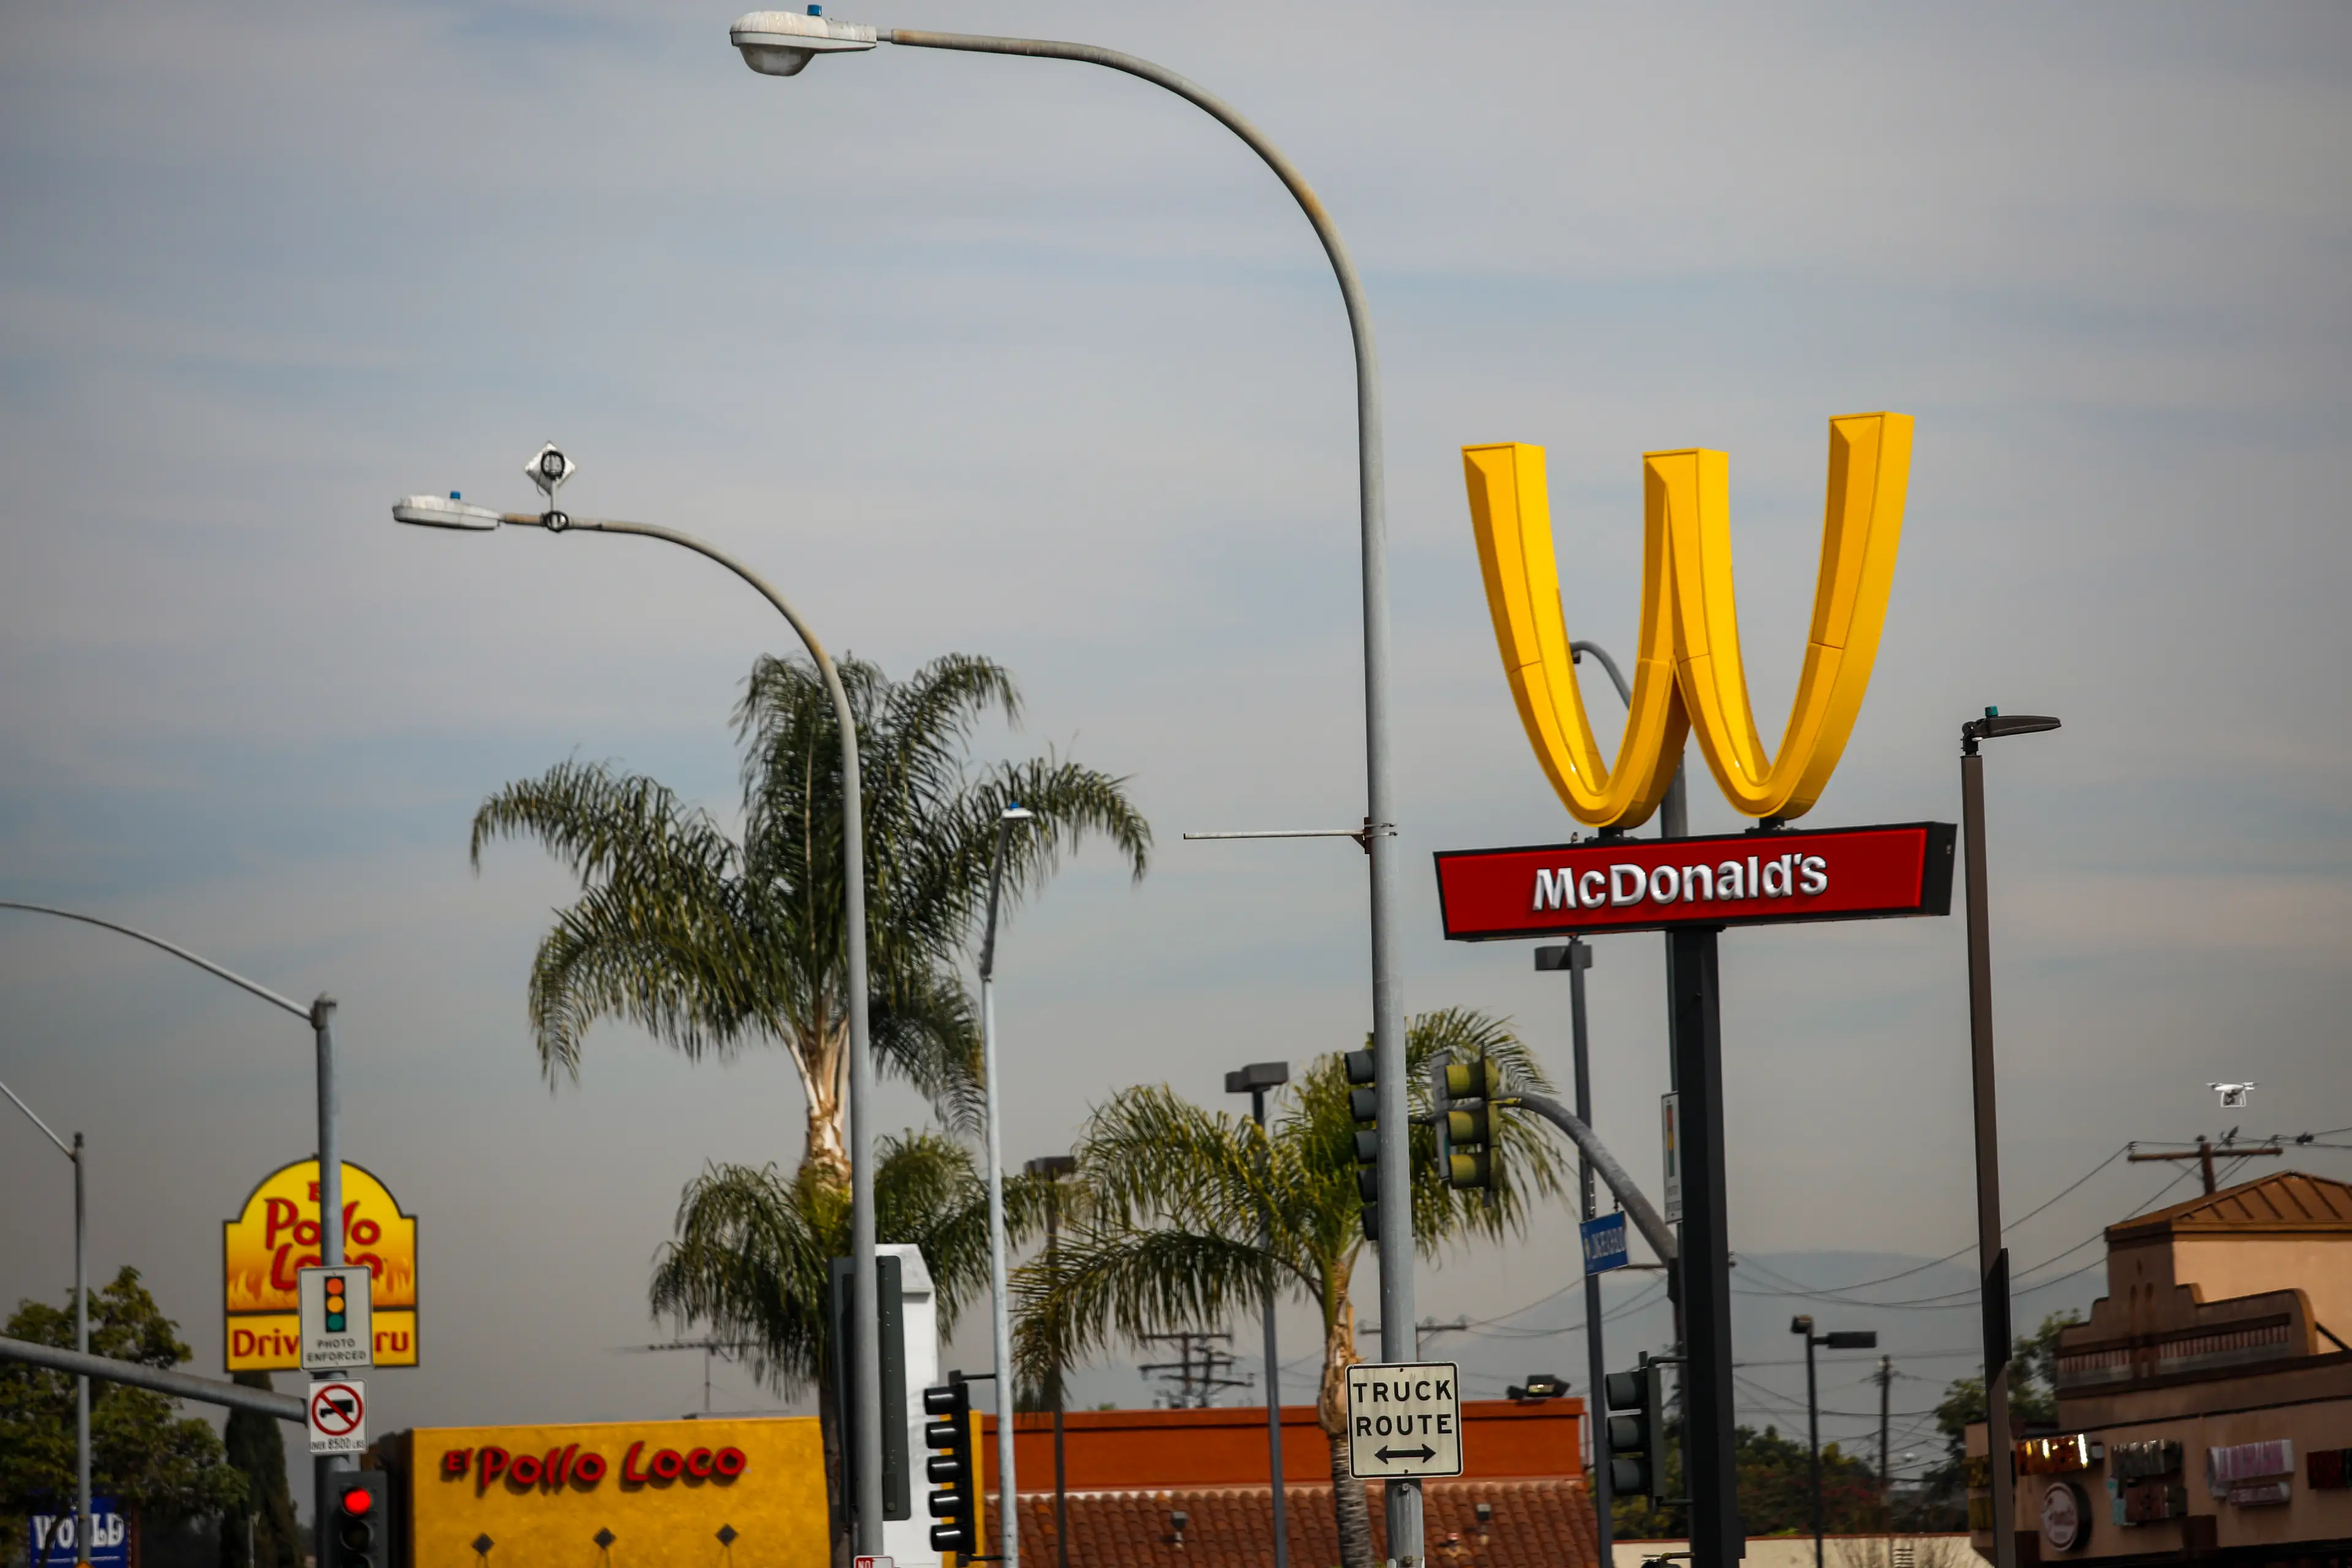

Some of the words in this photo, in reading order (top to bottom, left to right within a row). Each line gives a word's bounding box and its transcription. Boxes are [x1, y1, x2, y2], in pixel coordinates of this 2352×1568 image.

[1532, 853, 1828, 910] McDonald's
[264, 1197, 381, 1250] Polo
[233, 1328, 300, 1358] Driv
[374, 1331, 409, 1352] ru
[307, 1350, 366, 1362] ENFORCED
[317, 1338, 356, 1349] PHOTO
[1353, 1379, 1452, 1403] TRUCK
[1356, 1414, 1452, 1436] ROUTE
[447, 1447, 474, 1471] El
[480, 1443, 606, 1487] Pollo
[626, 1441, 747, 1482] Loco
